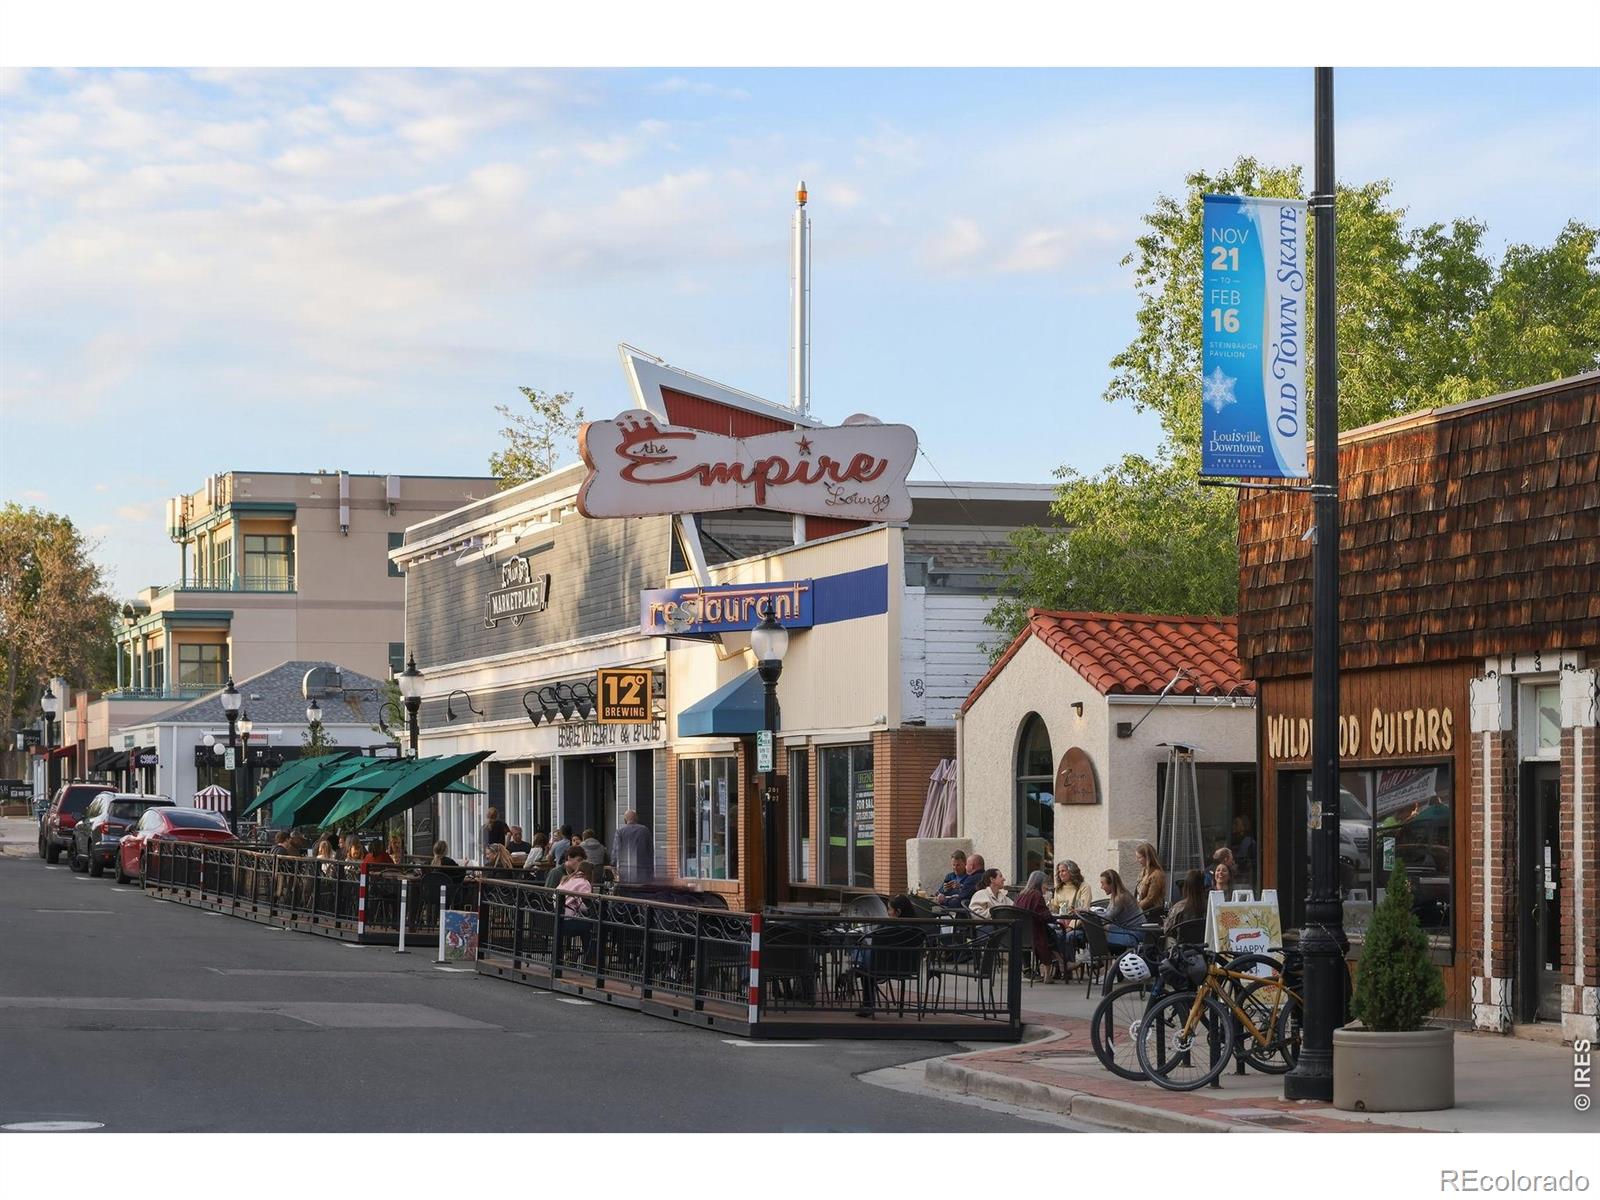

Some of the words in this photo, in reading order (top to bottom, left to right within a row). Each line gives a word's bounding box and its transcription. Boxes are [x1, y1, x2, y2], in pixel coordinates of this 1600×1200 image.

[1211, 228, 1249, 244] NOV
[1211, 246, 1239, 271] 21
[1276, 206, 1304, 292] SKATE
[1211, 290, 1241, 305] FEB
[1211, 308, 1240, 333] 16
[1209, 342, 1258, 350] STEINBAUGH
[1272, 296, 1298, 380] TOWN
[1276, 383, 1298, 438] OLD
[632, 441, 668, 455] the
[1209, 440, 1265, 453] Downtown
[1213, 429, 1261, 442] Louisville
[615, 428, 888, 505] Empire
[491, 587, 539, 614] MARKETPLACE
[650, 583, 808, 626] restaurant
[605, 706, 645, 717] BREWING
[558, 721, 616, 748] BREWERY
[633, 719, 661, 742] PUB
[1267, 713, 1360, 759] WILDOD
[1370, 707, 1452, 755] GUITARS
[1236, 945, 1265, 953] HAPPY
